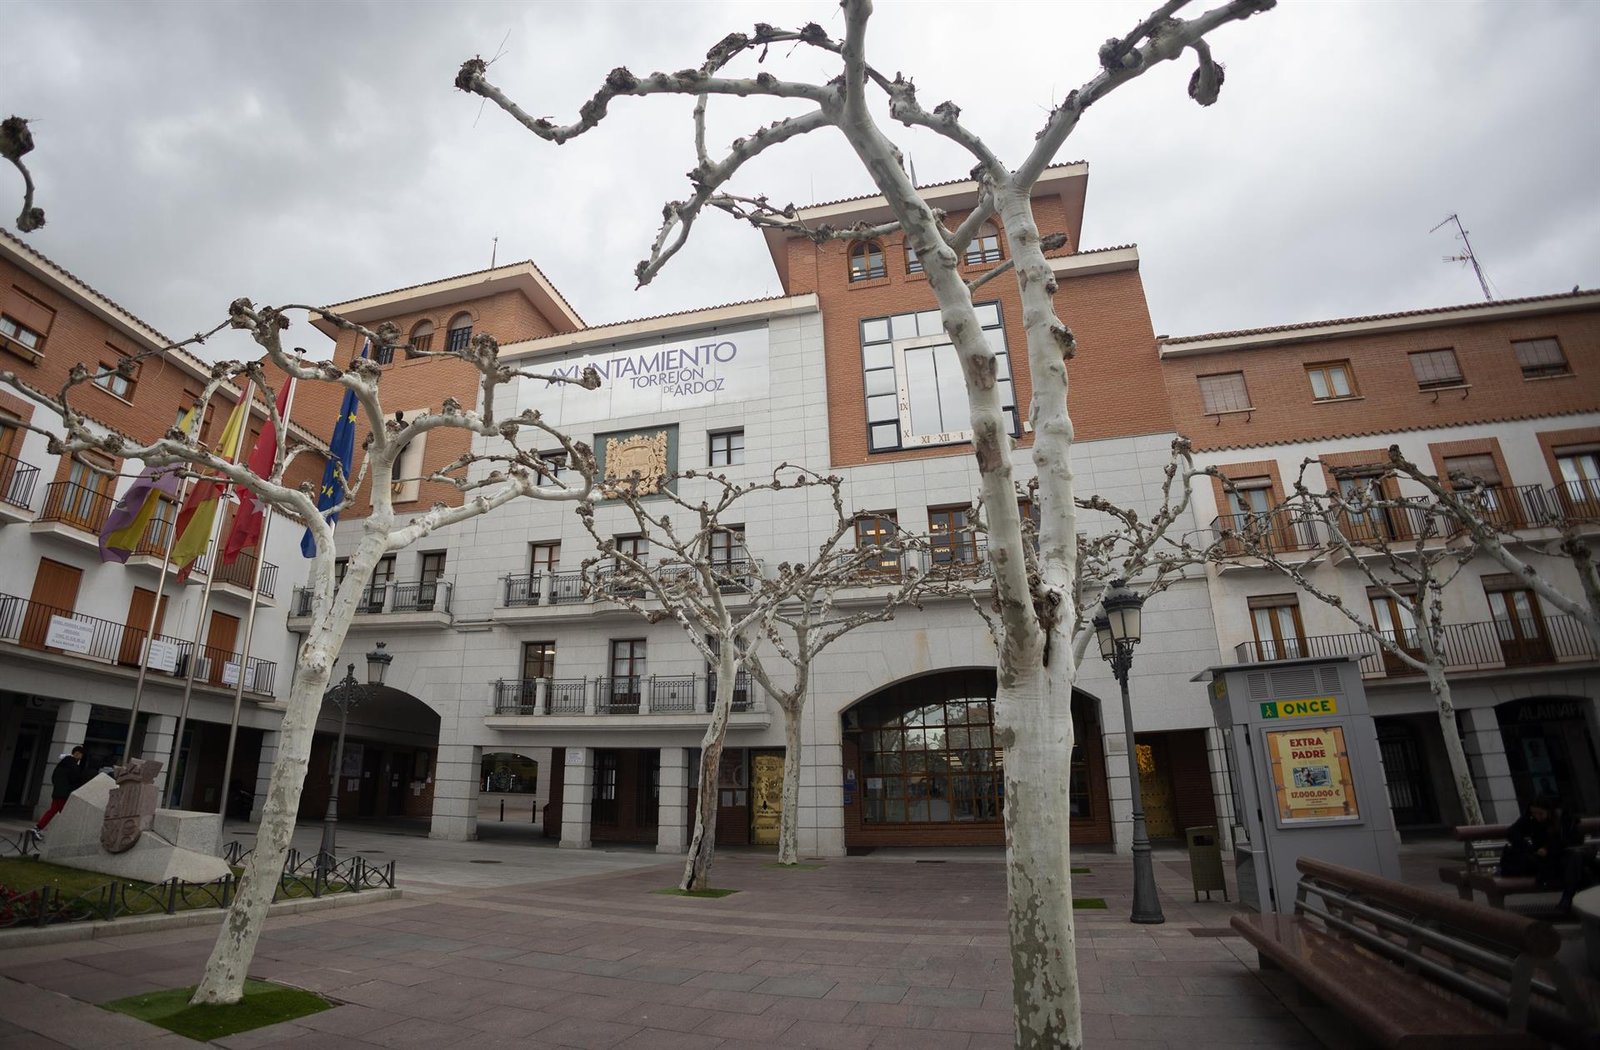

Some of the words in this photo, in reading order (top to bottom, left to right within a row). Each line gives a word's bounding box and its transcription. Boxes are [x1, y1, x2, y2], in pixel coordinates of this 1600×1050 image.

[630, 366, 704, 389] TORREJÓN
[663, 385, 674, 394] DE
[673, 378, 725, 397] ARDOZ
[900, 403, 908, 411] IX
[904, 430, 910, 438] X
[921, 435, 931, 443] XI
[938, 434, 950, 442] XII
[1283, 700, 1331, 715] ONCE
[1289, 737, 1323, 748] EXTRA
[1291, 749, 1326, 760] PADRE
